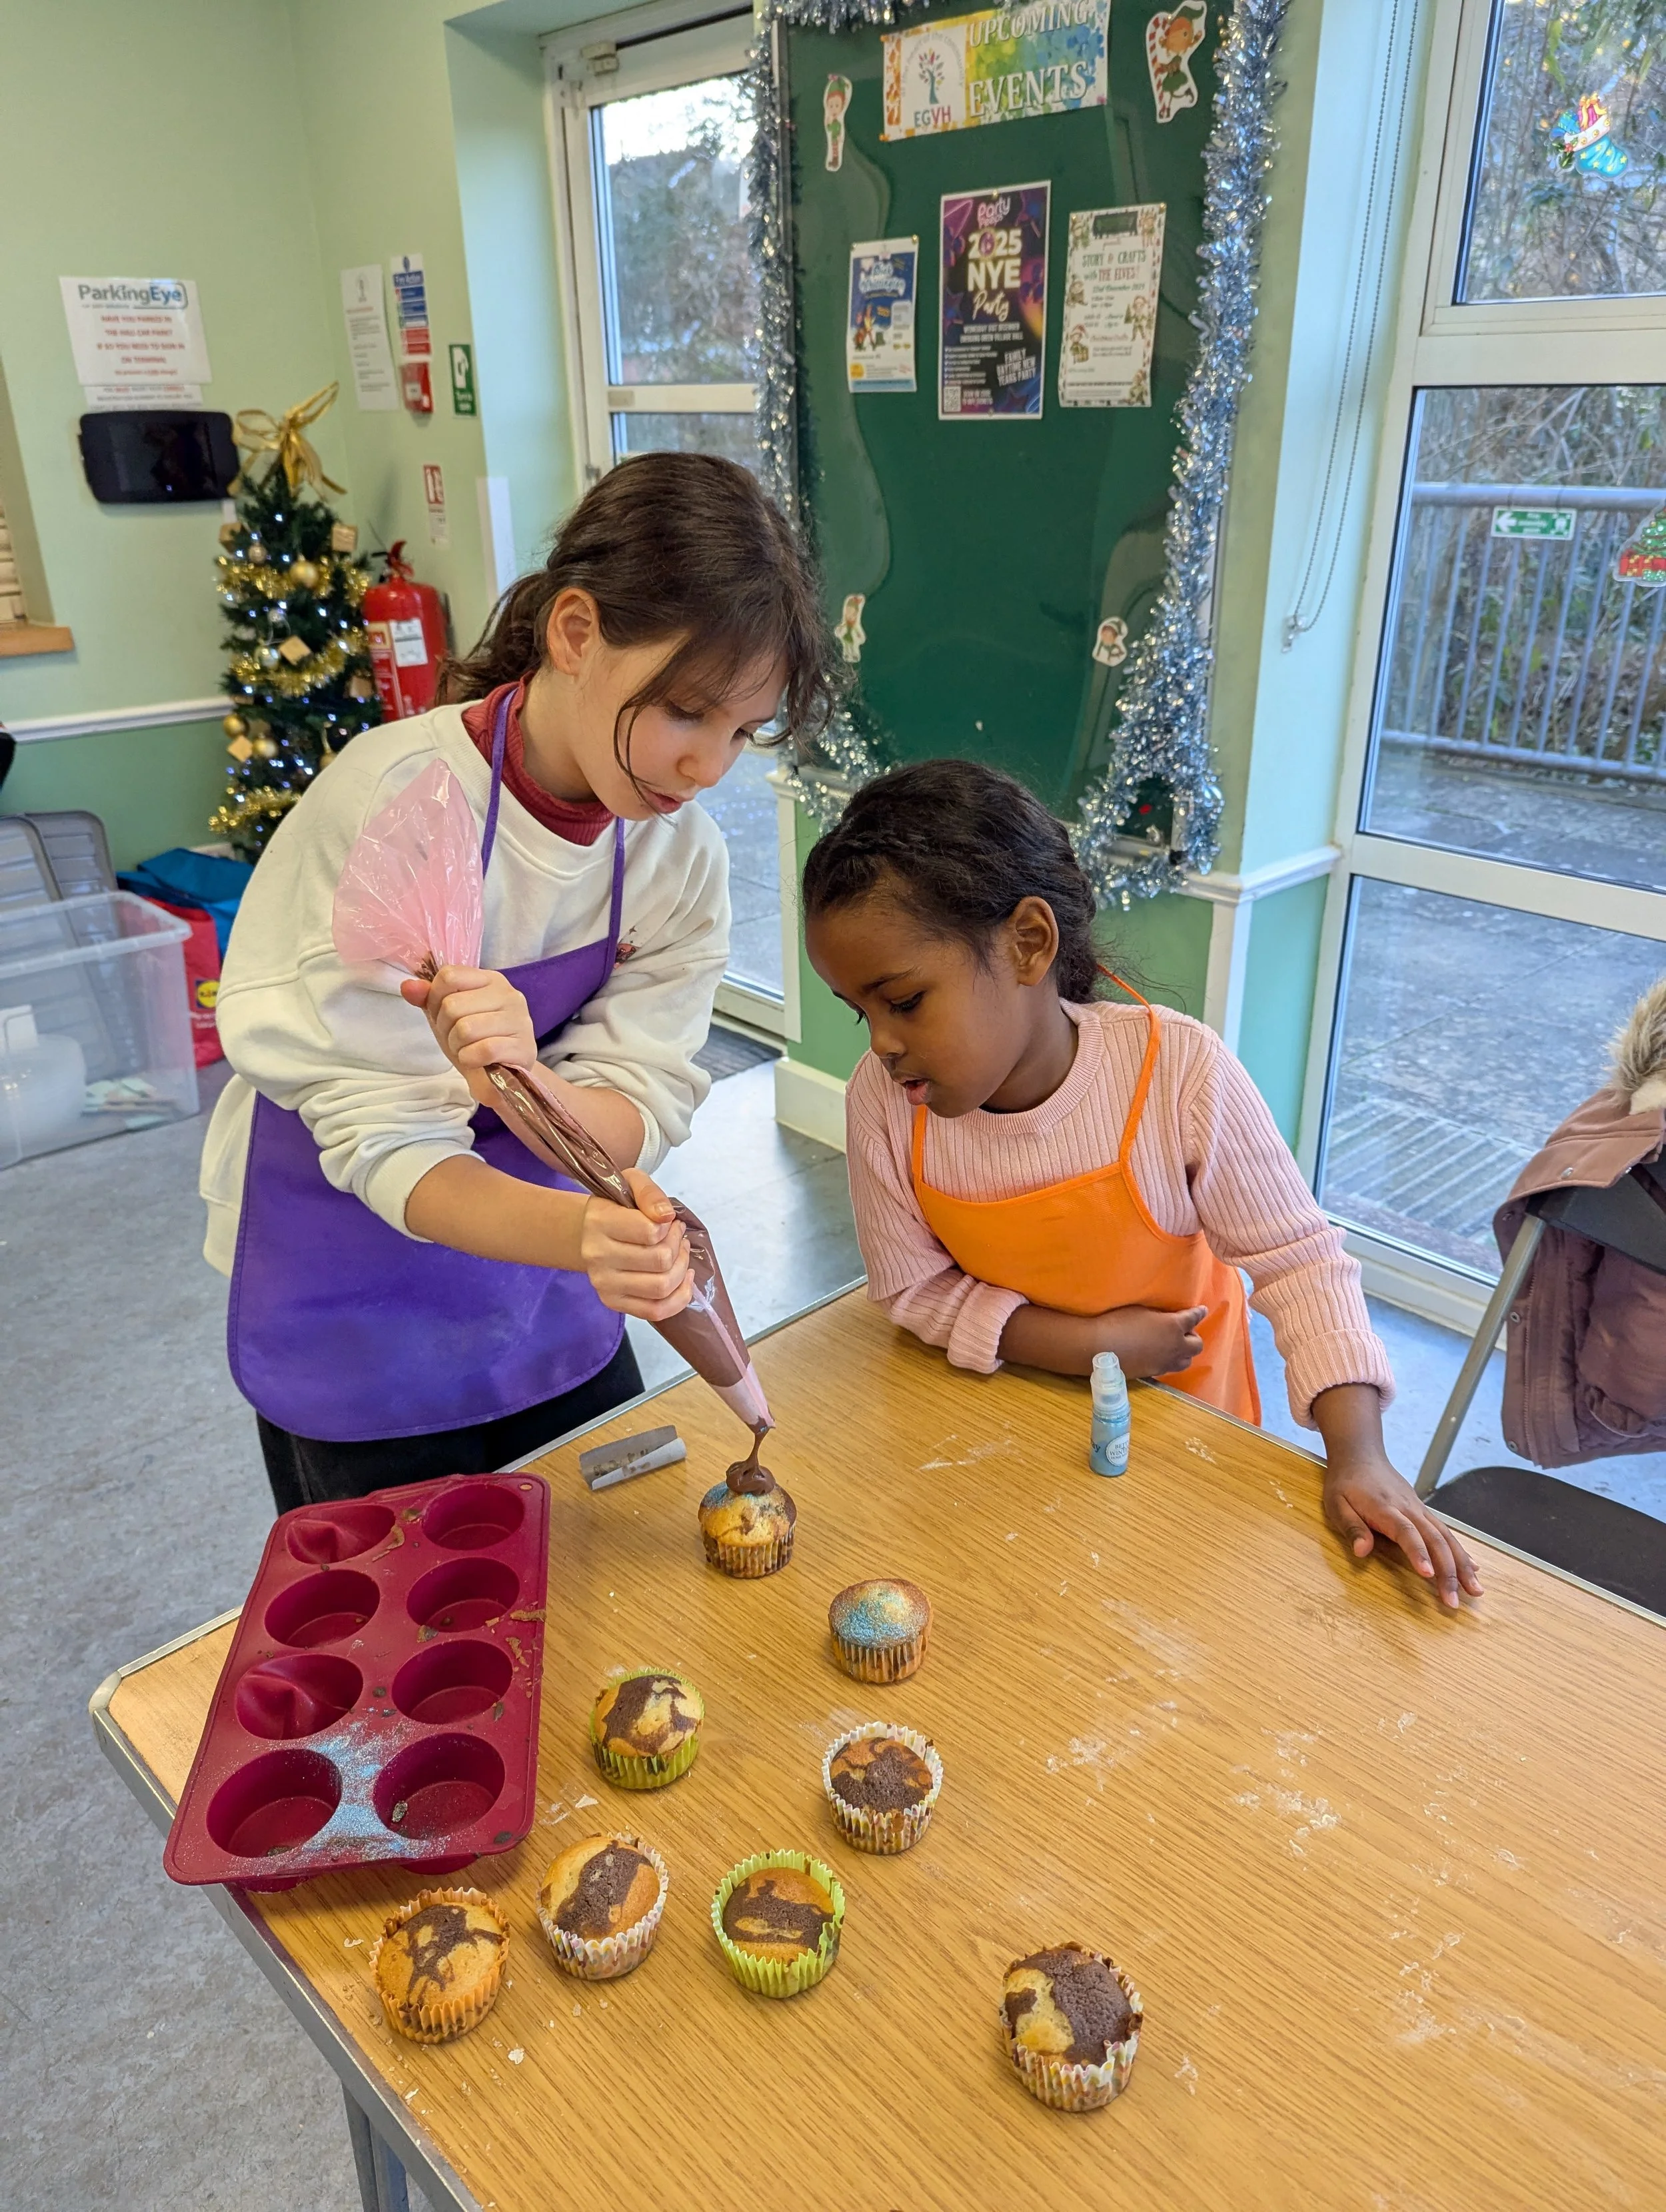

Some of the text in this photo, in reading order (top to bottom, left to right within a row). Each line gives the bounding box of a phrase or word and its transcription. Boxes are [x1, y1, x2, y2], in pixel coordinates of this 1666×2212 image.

[969, 0, 1089, 47] UPCOMING
[968, 61, 1089, 119] EVENTS
[914, 105, 952, 128] EGVH
[968, 229, 1022, 260] 2025
[968, 259, 1022, 291] NYE
[77, 283, 183, 305] ParkingEye
[972, 289, 1010, 322] Party
